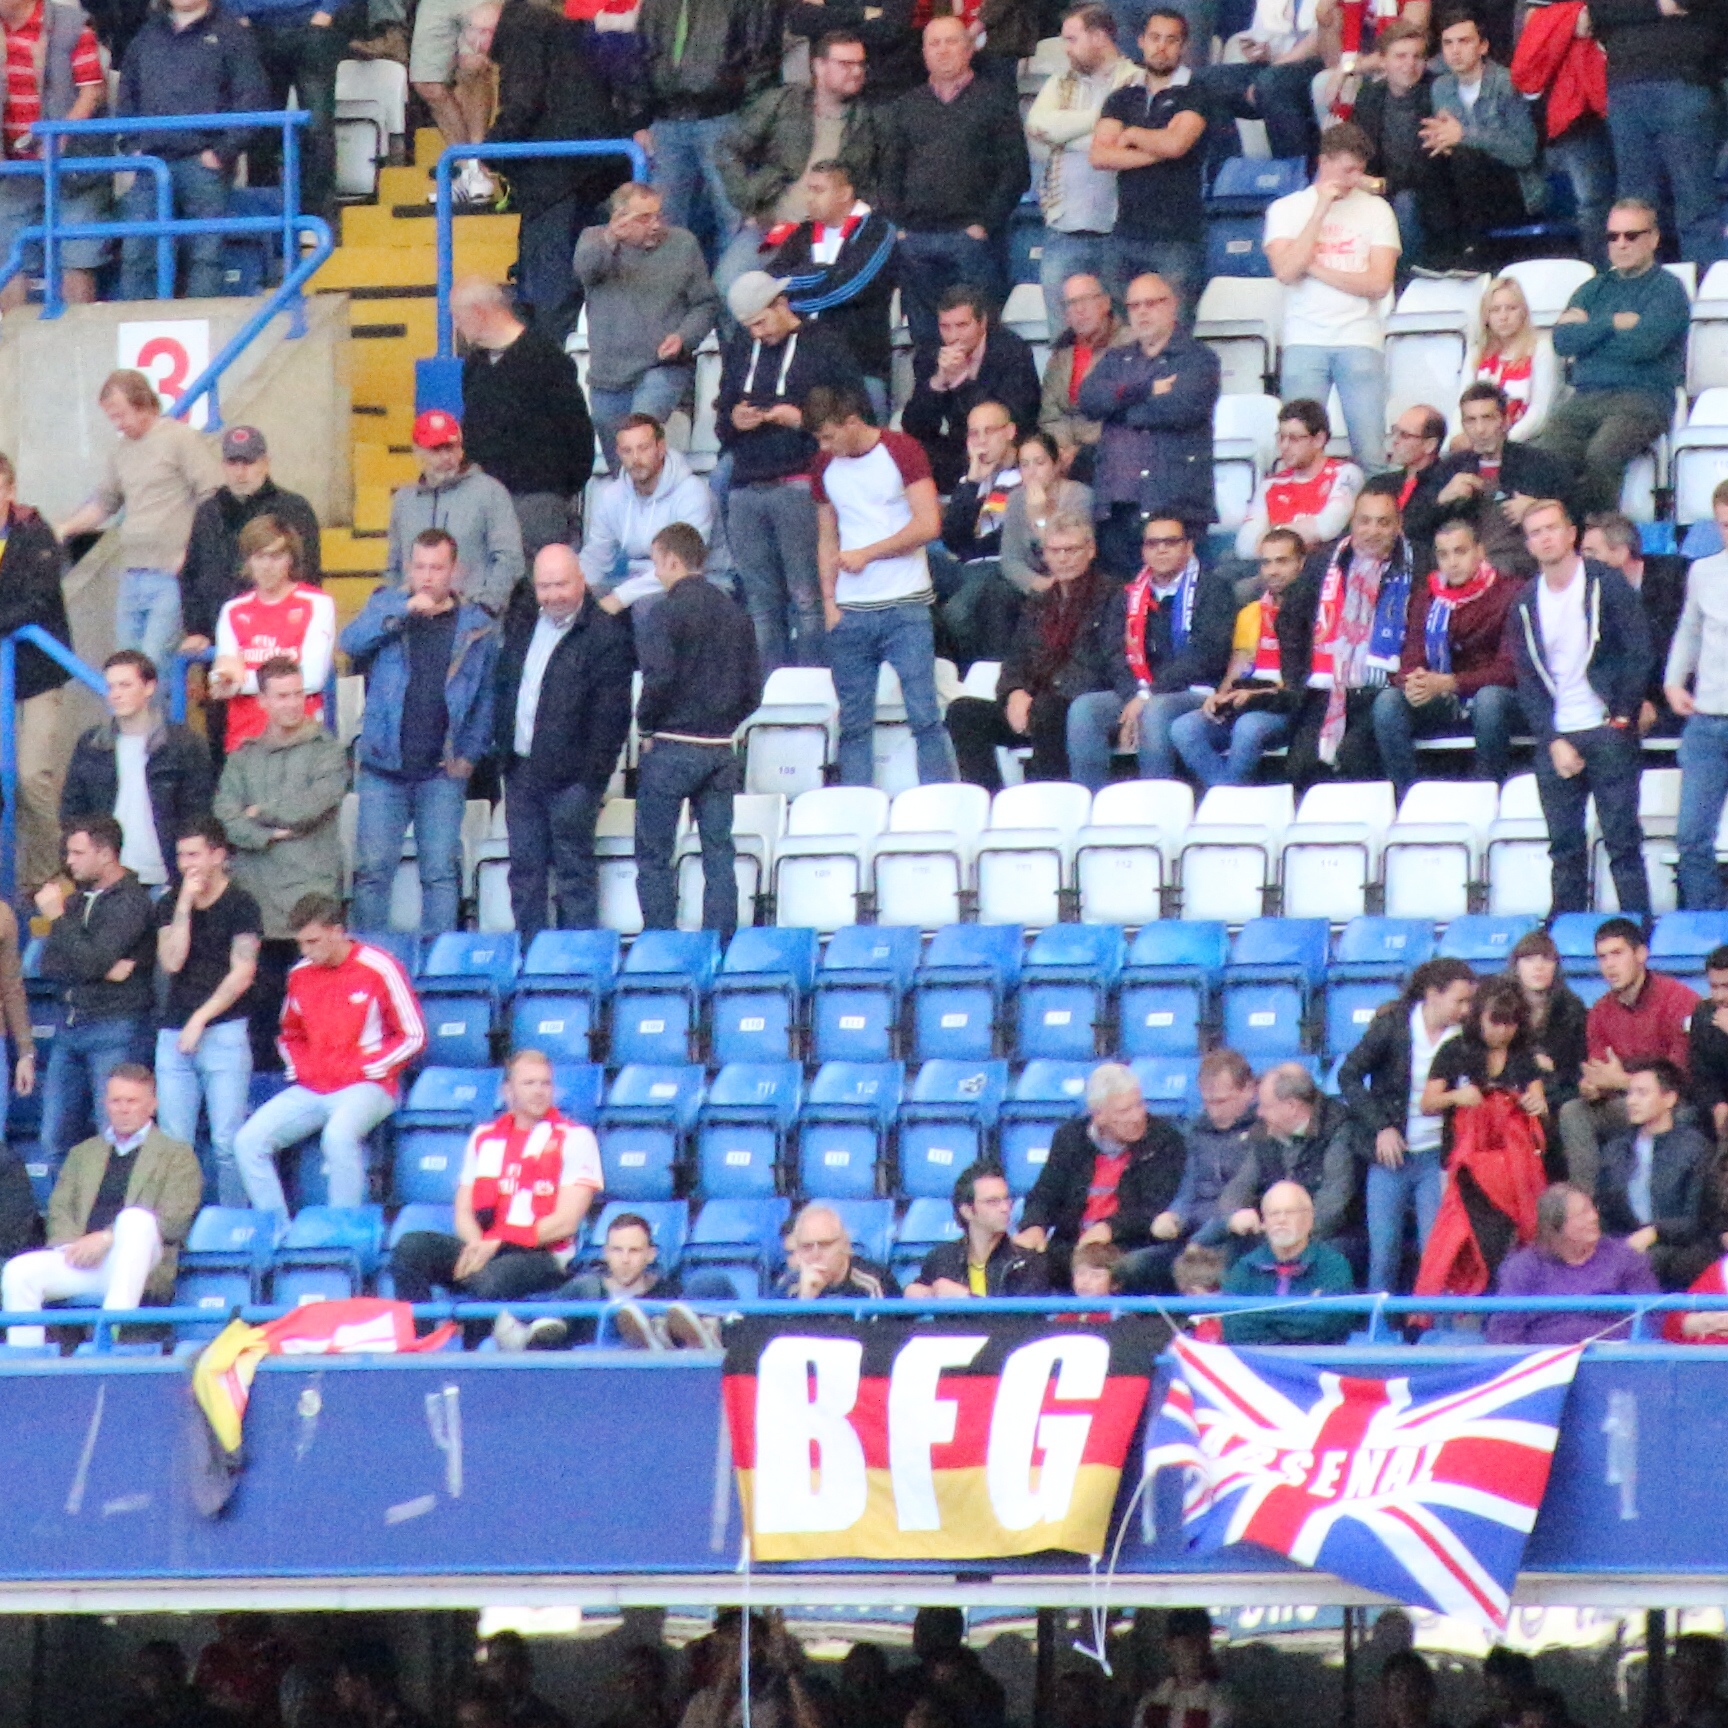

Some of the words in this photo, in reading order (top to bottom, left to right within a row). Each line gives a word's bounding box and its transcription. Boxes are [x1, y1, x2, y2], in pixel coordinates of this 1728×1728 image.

[137, 337, 190, 425] 3
[754, 1334, 1110, 1534] BFG
[1199, 1432, 1445, 1499] ARSENAL
